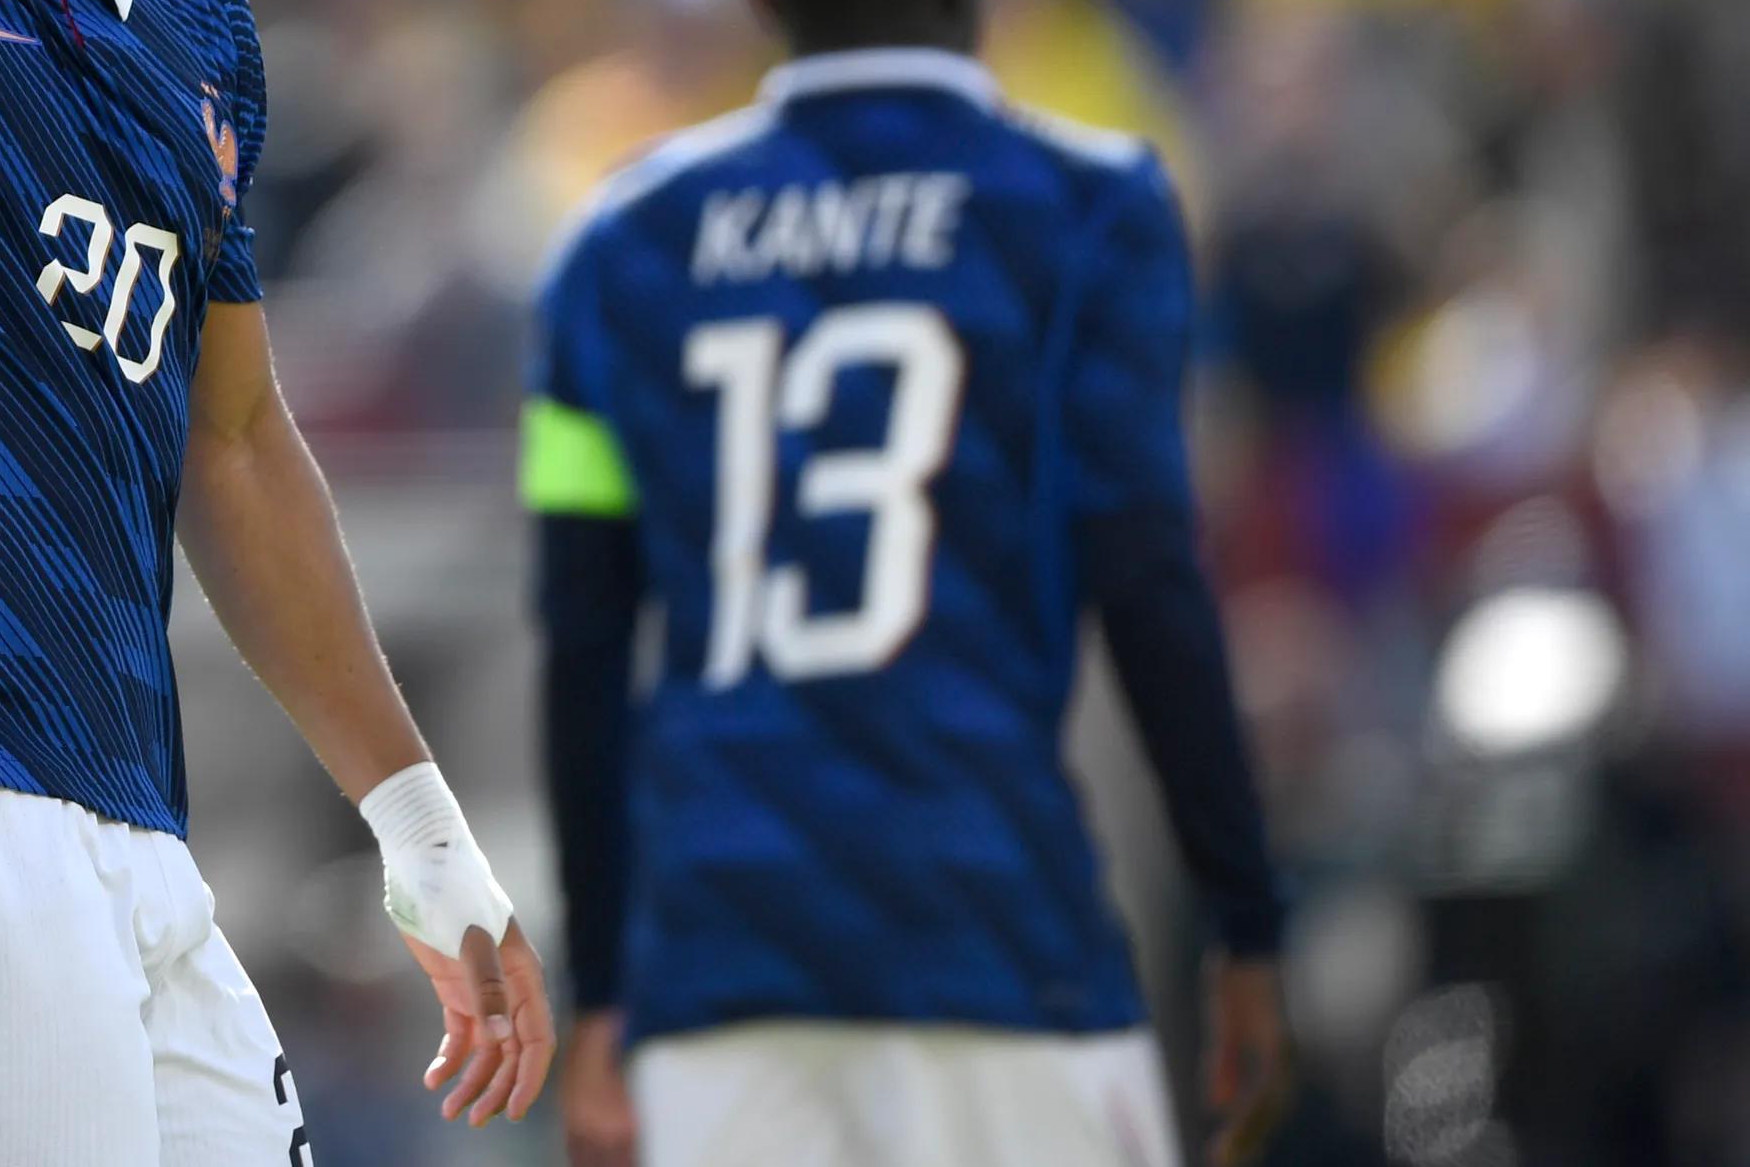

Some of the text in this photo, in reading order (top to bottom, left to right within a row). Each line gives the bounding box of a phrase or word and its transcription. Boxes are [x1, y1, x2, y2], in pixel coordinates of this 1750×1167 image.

[36, 192, 178, 385] 20
[688, 170, 970, 287] KANTE
[681, 300, 967, 694] 13
